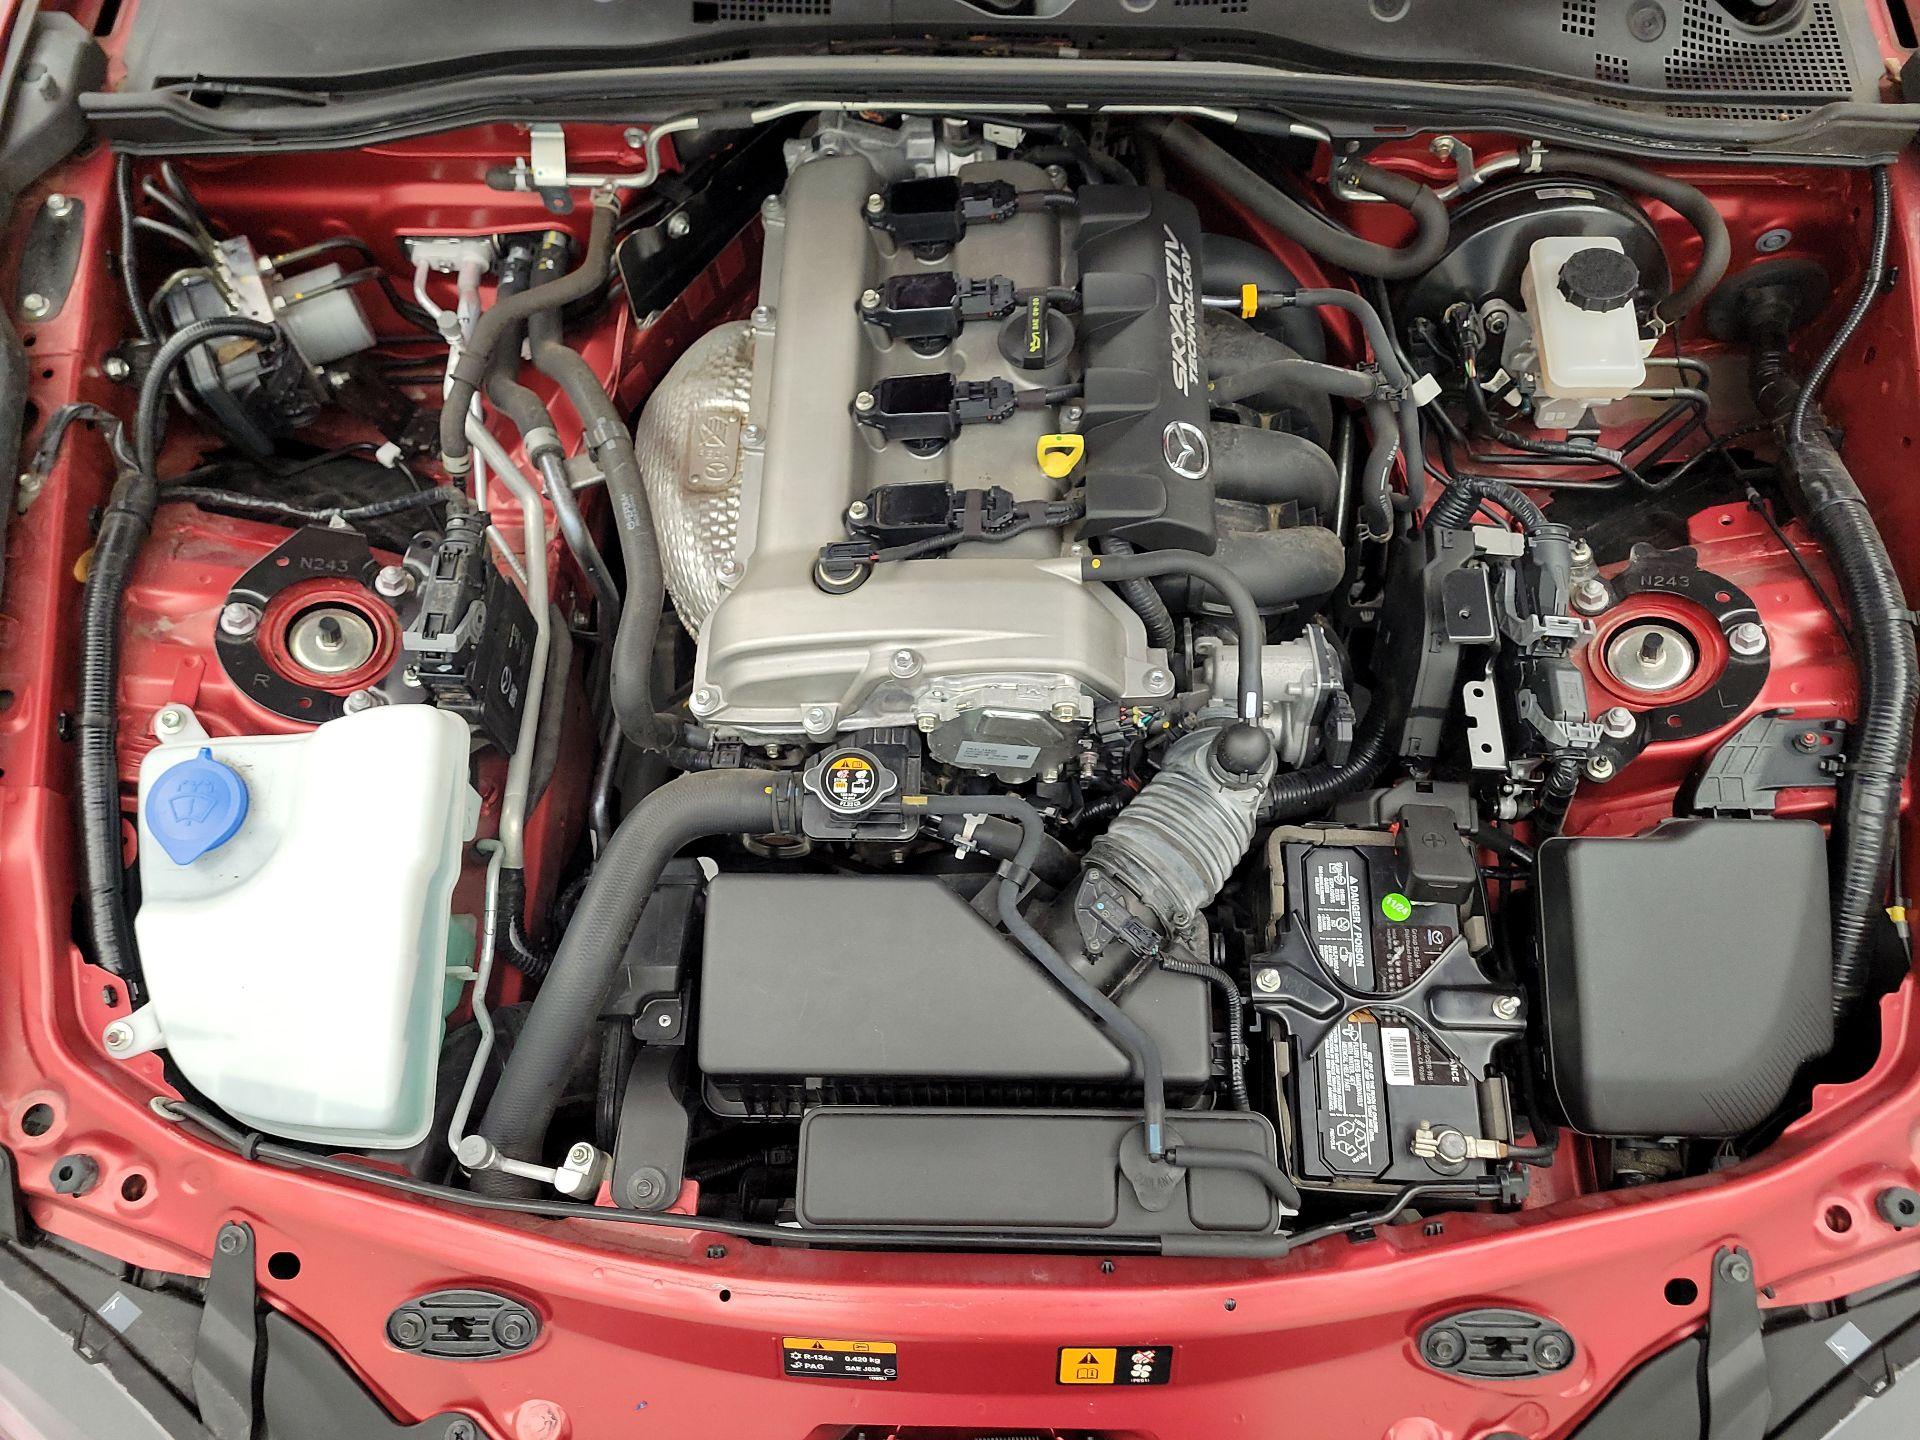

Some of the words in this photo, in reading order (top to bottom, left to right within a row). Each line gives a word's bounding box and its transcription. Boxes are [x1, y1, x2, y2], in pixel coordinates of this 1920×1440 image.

[1164, 224, 1189, 398] SKYACTIV
[1181, 242, 1199, 386] TECHNOLOGY
[299, 556, 349, 572] N243
[1639, 574, 1690, 587] N243
[252, 672, 270, 688] R
[1716, 688, 1738, 708] L
[1350, 885, 1361, 924] DANGER
[1354, 932, 1365, 967] POISON
[1405, 928, 1413, 954] Distributed
[803, 1353, 834, 1362] R-134a
[844, 1355, 868, 1363] 0.420
[869, 1356, 881, 1365] kg
